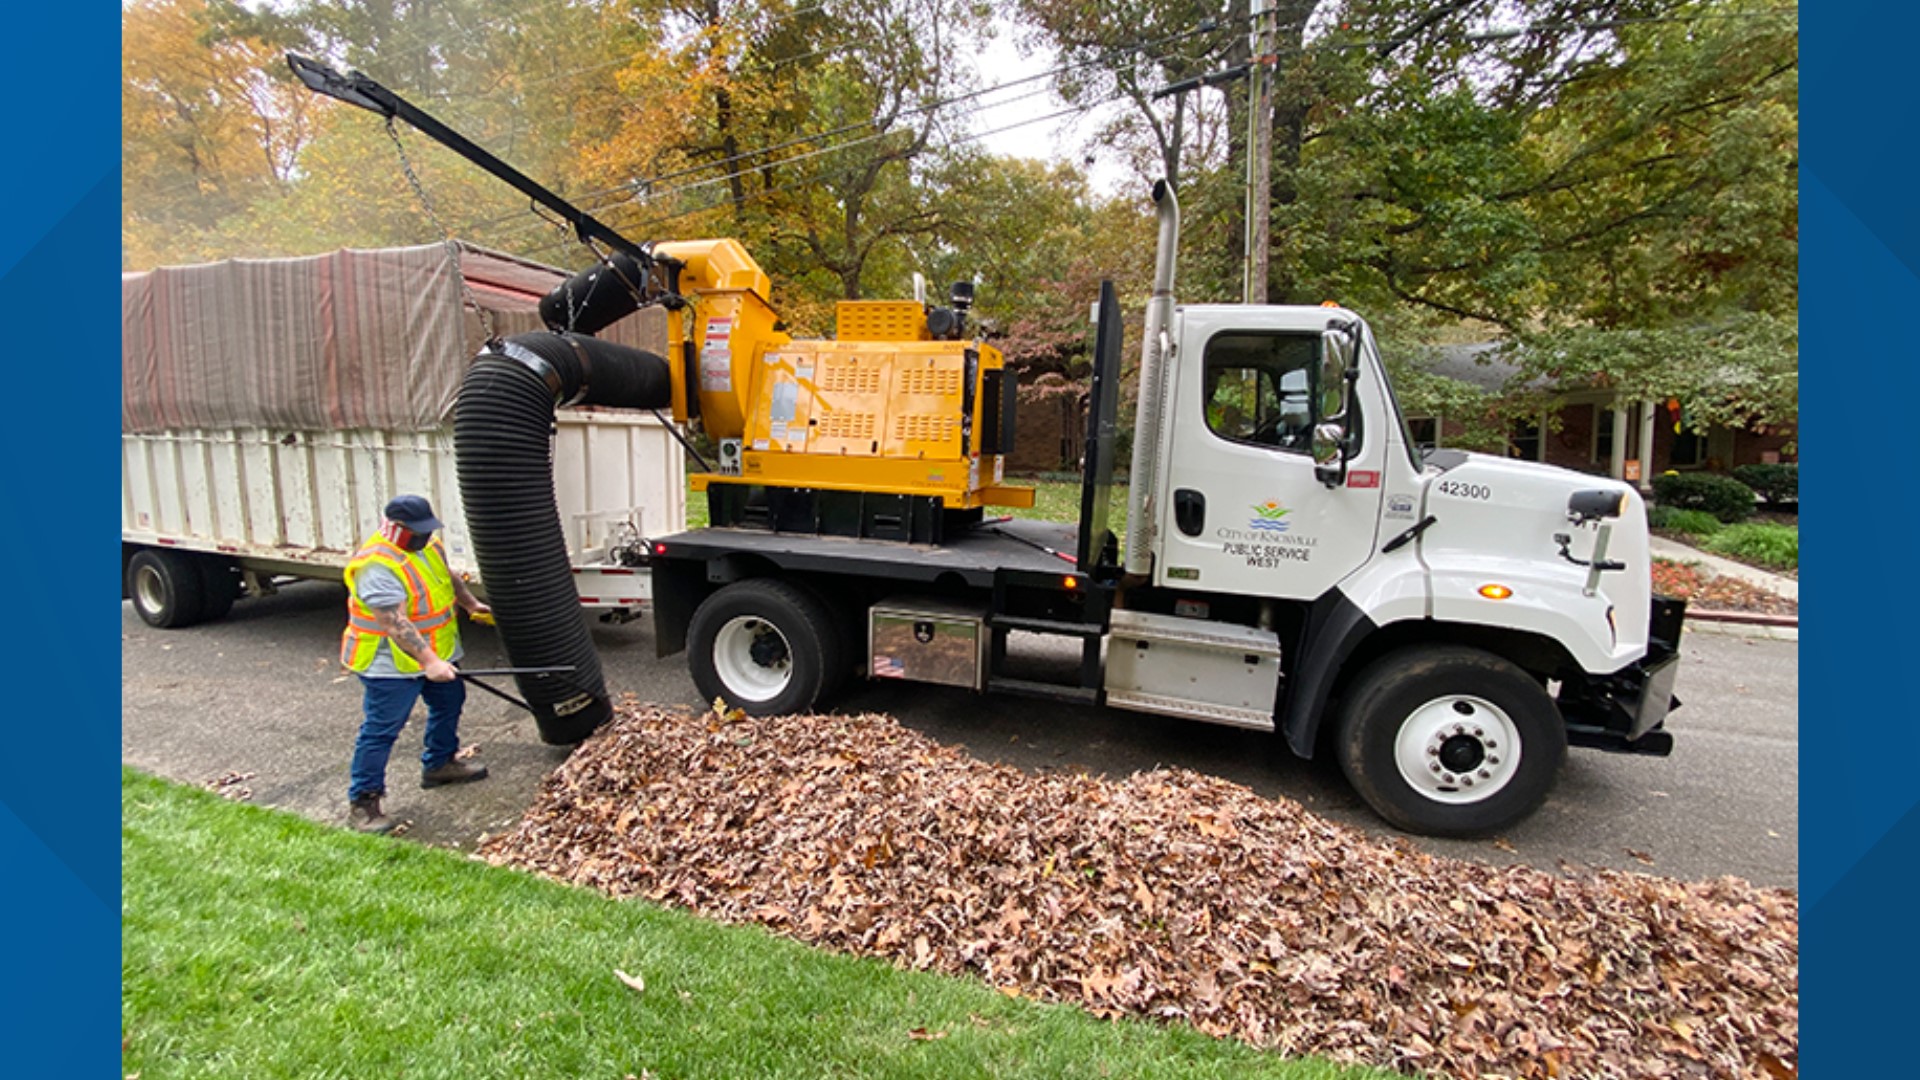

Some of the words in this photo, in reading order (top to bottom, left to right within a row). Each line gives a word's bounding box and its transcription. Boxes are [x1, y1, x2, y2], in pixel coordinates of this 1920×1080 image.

[1439, 481, 1491, 500] 42300
[1223, 542, 1262, 557] PUBLIC
[1263, 545, 1310, 561] SERVICE
[1247, 556, 1280, 568] WEST
